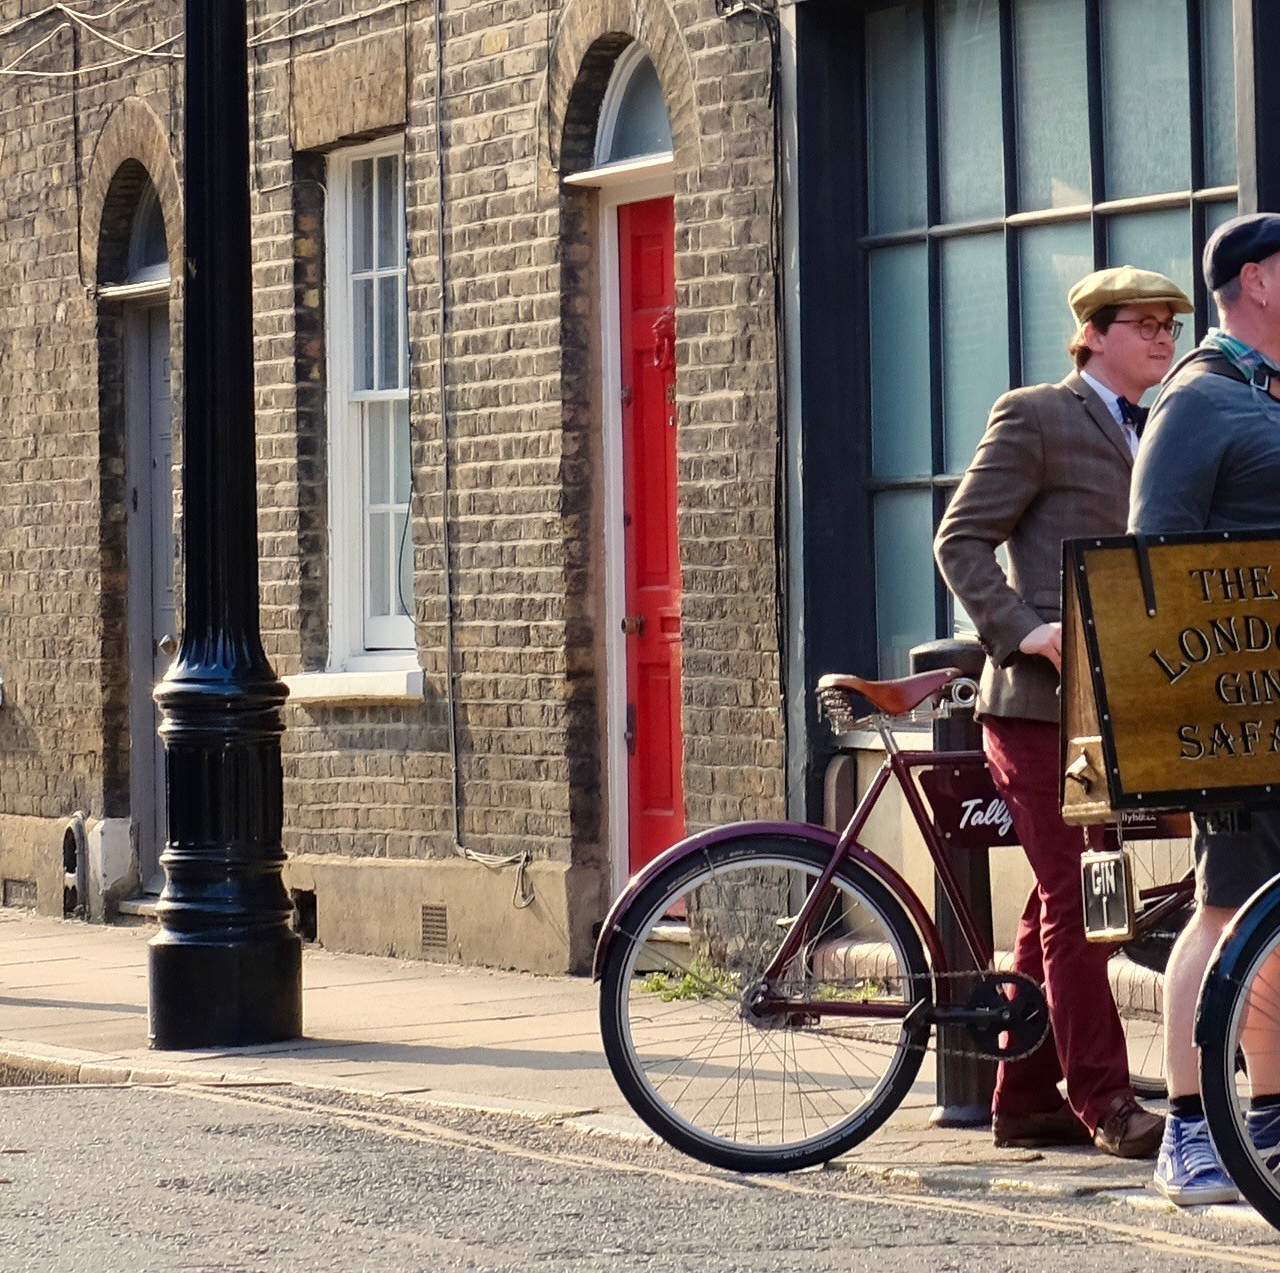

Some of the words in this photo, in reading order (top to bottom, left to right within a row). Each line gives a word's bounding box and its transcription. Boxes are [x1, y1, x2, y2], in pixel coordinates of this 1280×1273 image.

[1188, 564, 1279, 604] THE
[959, 798, 1013, 837] Tally
[1091, 861, 1116, 896] GIN
